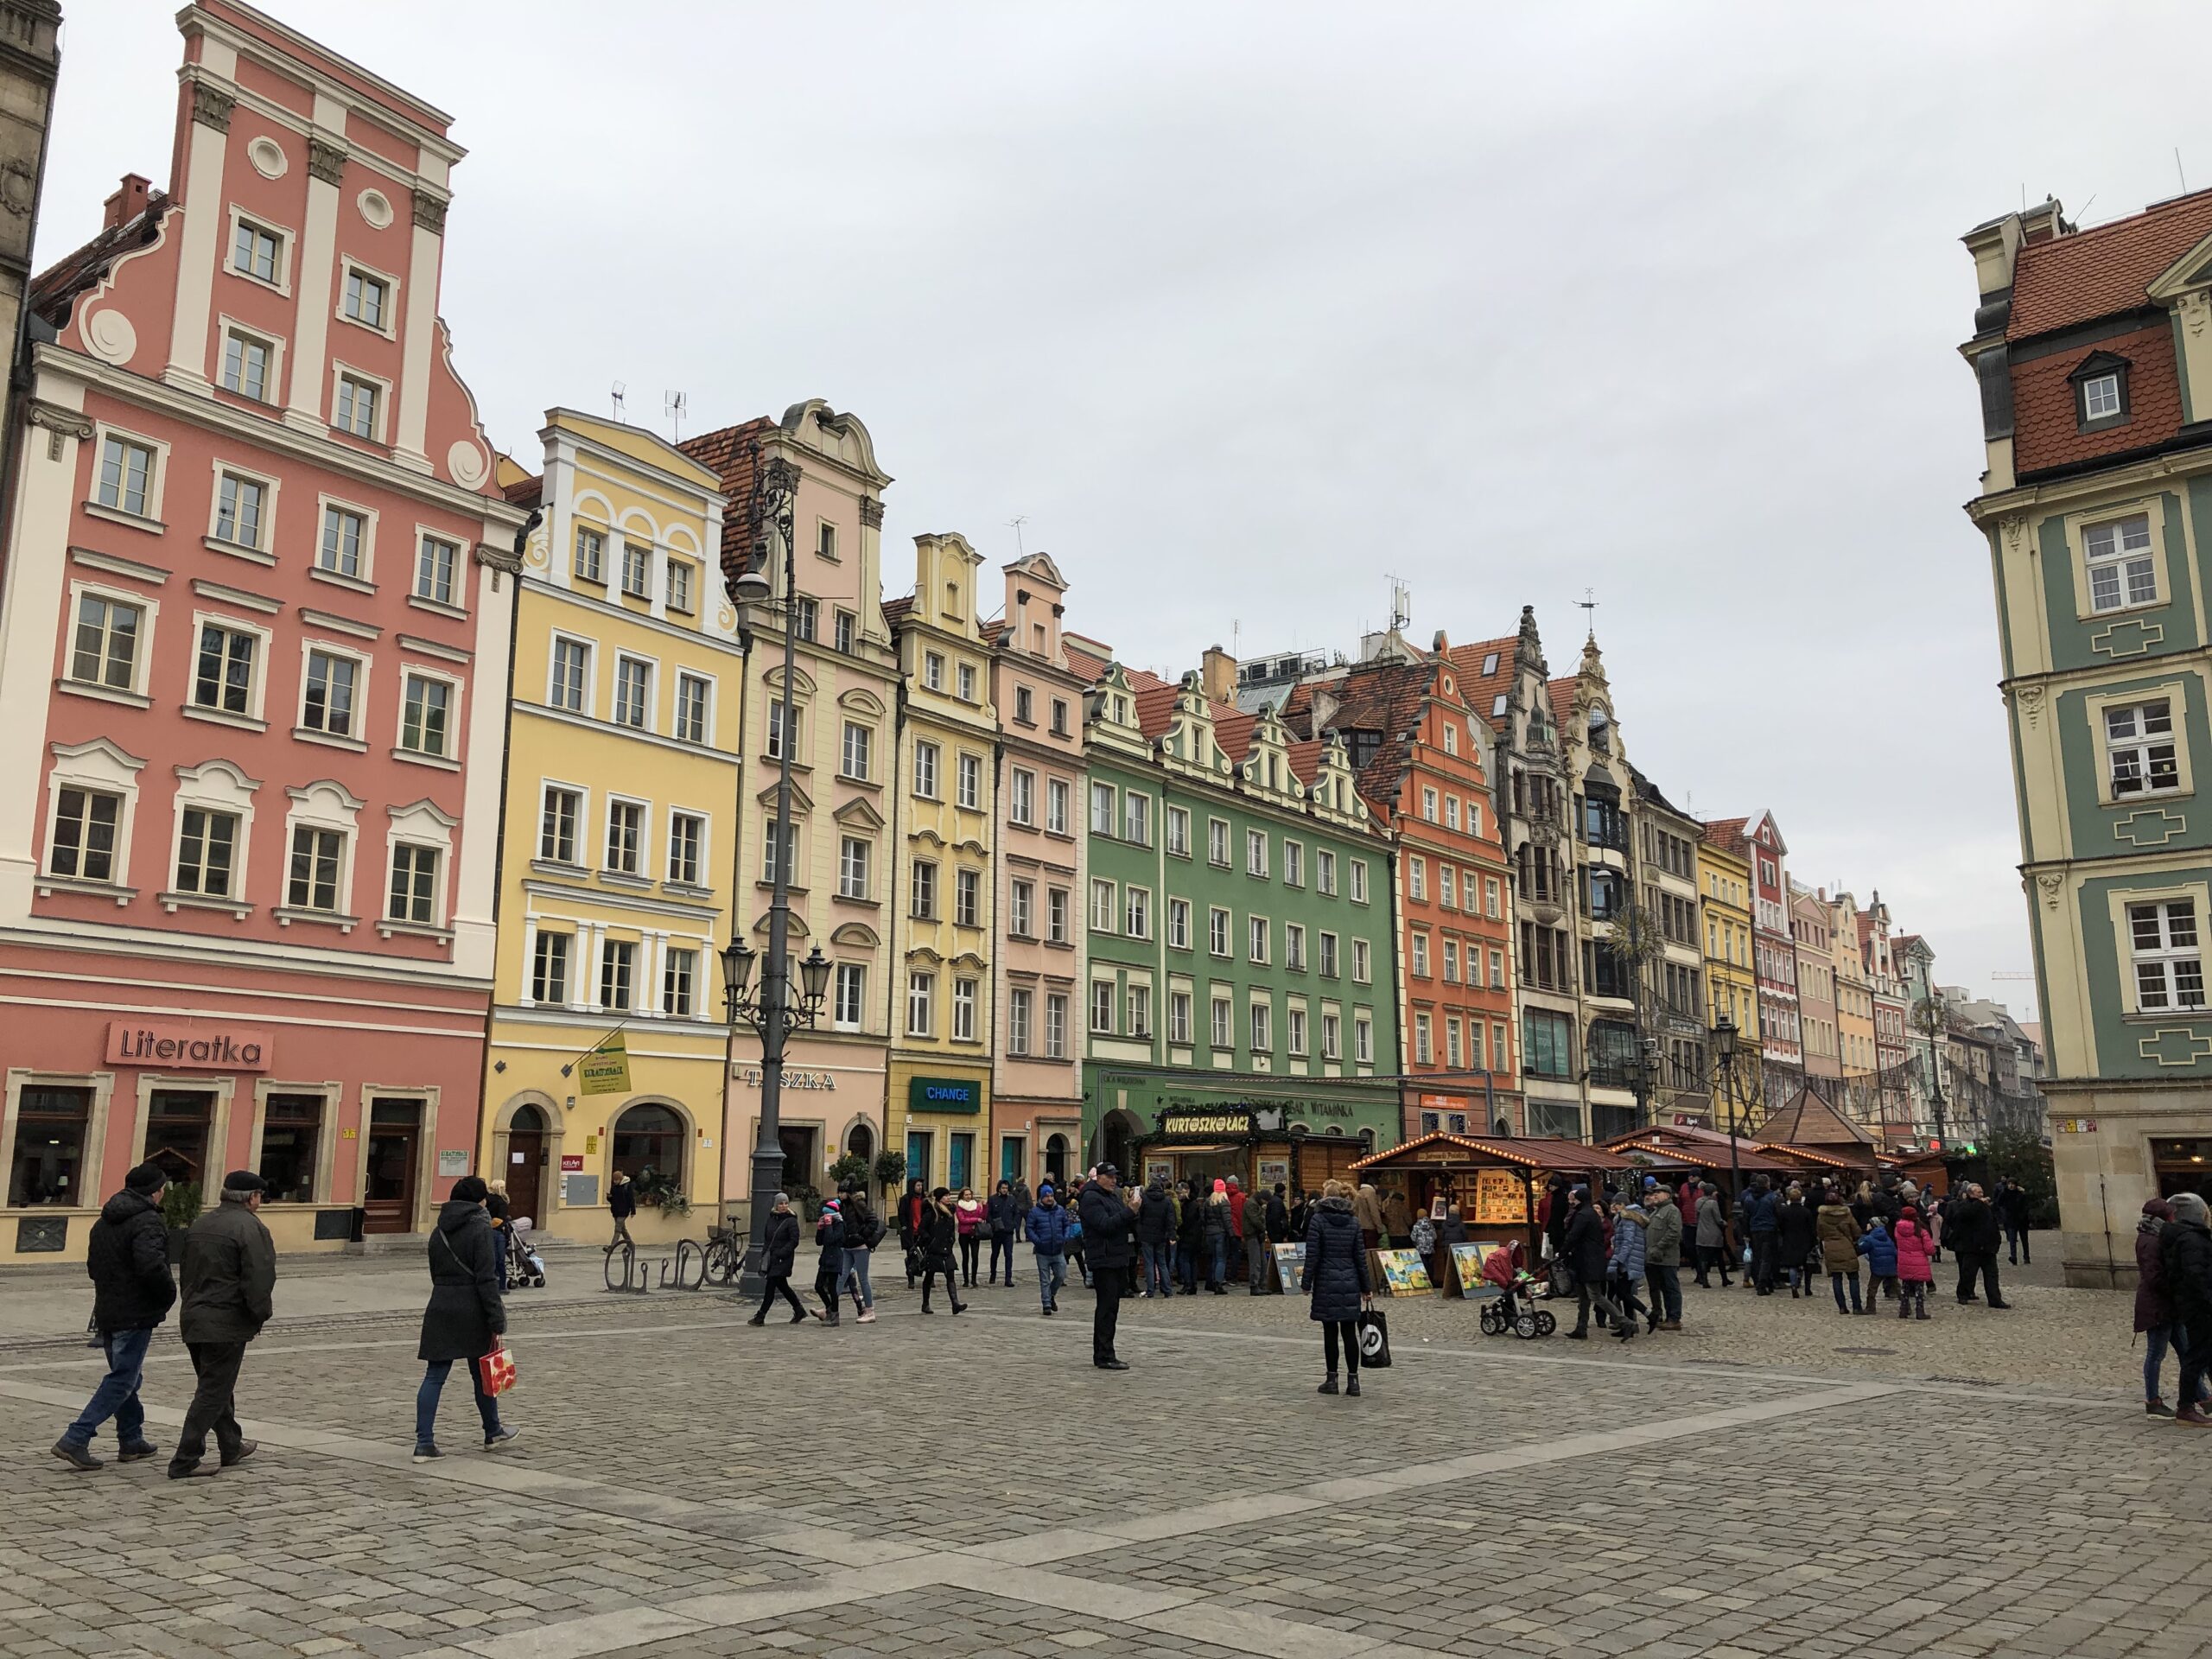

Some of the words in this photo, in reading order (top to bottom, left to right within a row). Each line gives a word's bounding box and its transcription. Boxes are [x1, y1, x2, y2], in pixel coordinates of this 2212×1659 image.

[121, 1029, 261, 1064] Literatka
[746, 1070, 837, 1090] TSZKA
[926, 1086, 969, 1101] CHANGE
[1311, 1101, 1353, 1117] WITAMINKA
